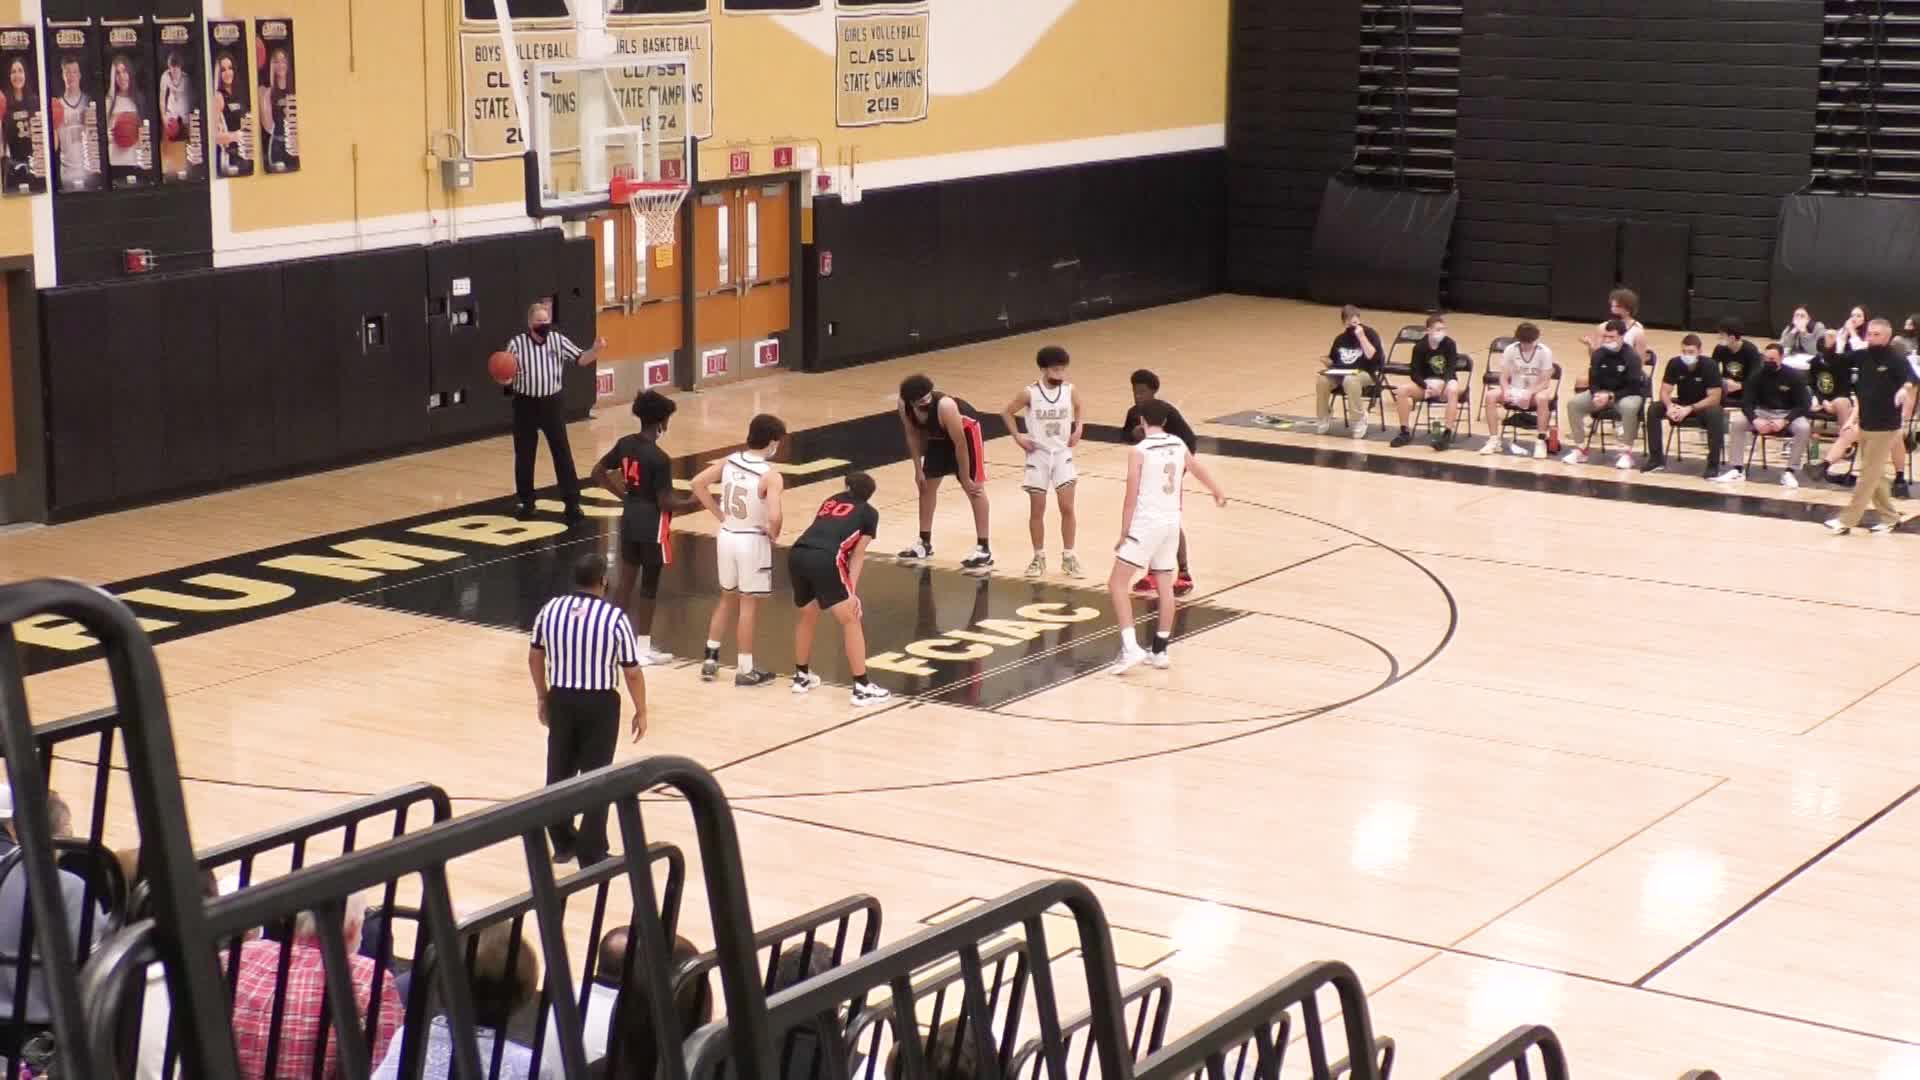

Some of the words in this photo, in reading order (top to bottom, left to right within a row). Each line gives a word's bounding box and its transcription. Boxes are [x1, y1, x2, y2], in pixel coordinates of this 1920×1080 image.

[844, 27, 867, 42] GIRLS
[871, 24, 921, 40] VOLLEYBALL
[475, 46, 501, 62] BOYS
[616, 39, 637, 55] IRLS
[642, 35, 702, 54] BASKETBALL
[849, 47, 895, 64] CLASS
[898, 47, 916, 62] LL
[844, 73, 870, 92] STATE
[874, 69, 922, 90] CHAMPIONS
[474, 97, 510, 120] STATE
[867, 97, 899, 113] 2019
[622, 456, 641, 487] 14
[1163, 462, 1177, 495] 3
[724, 482, 748, 520] 15
[865, 602, 1101, 677] FCIAC
